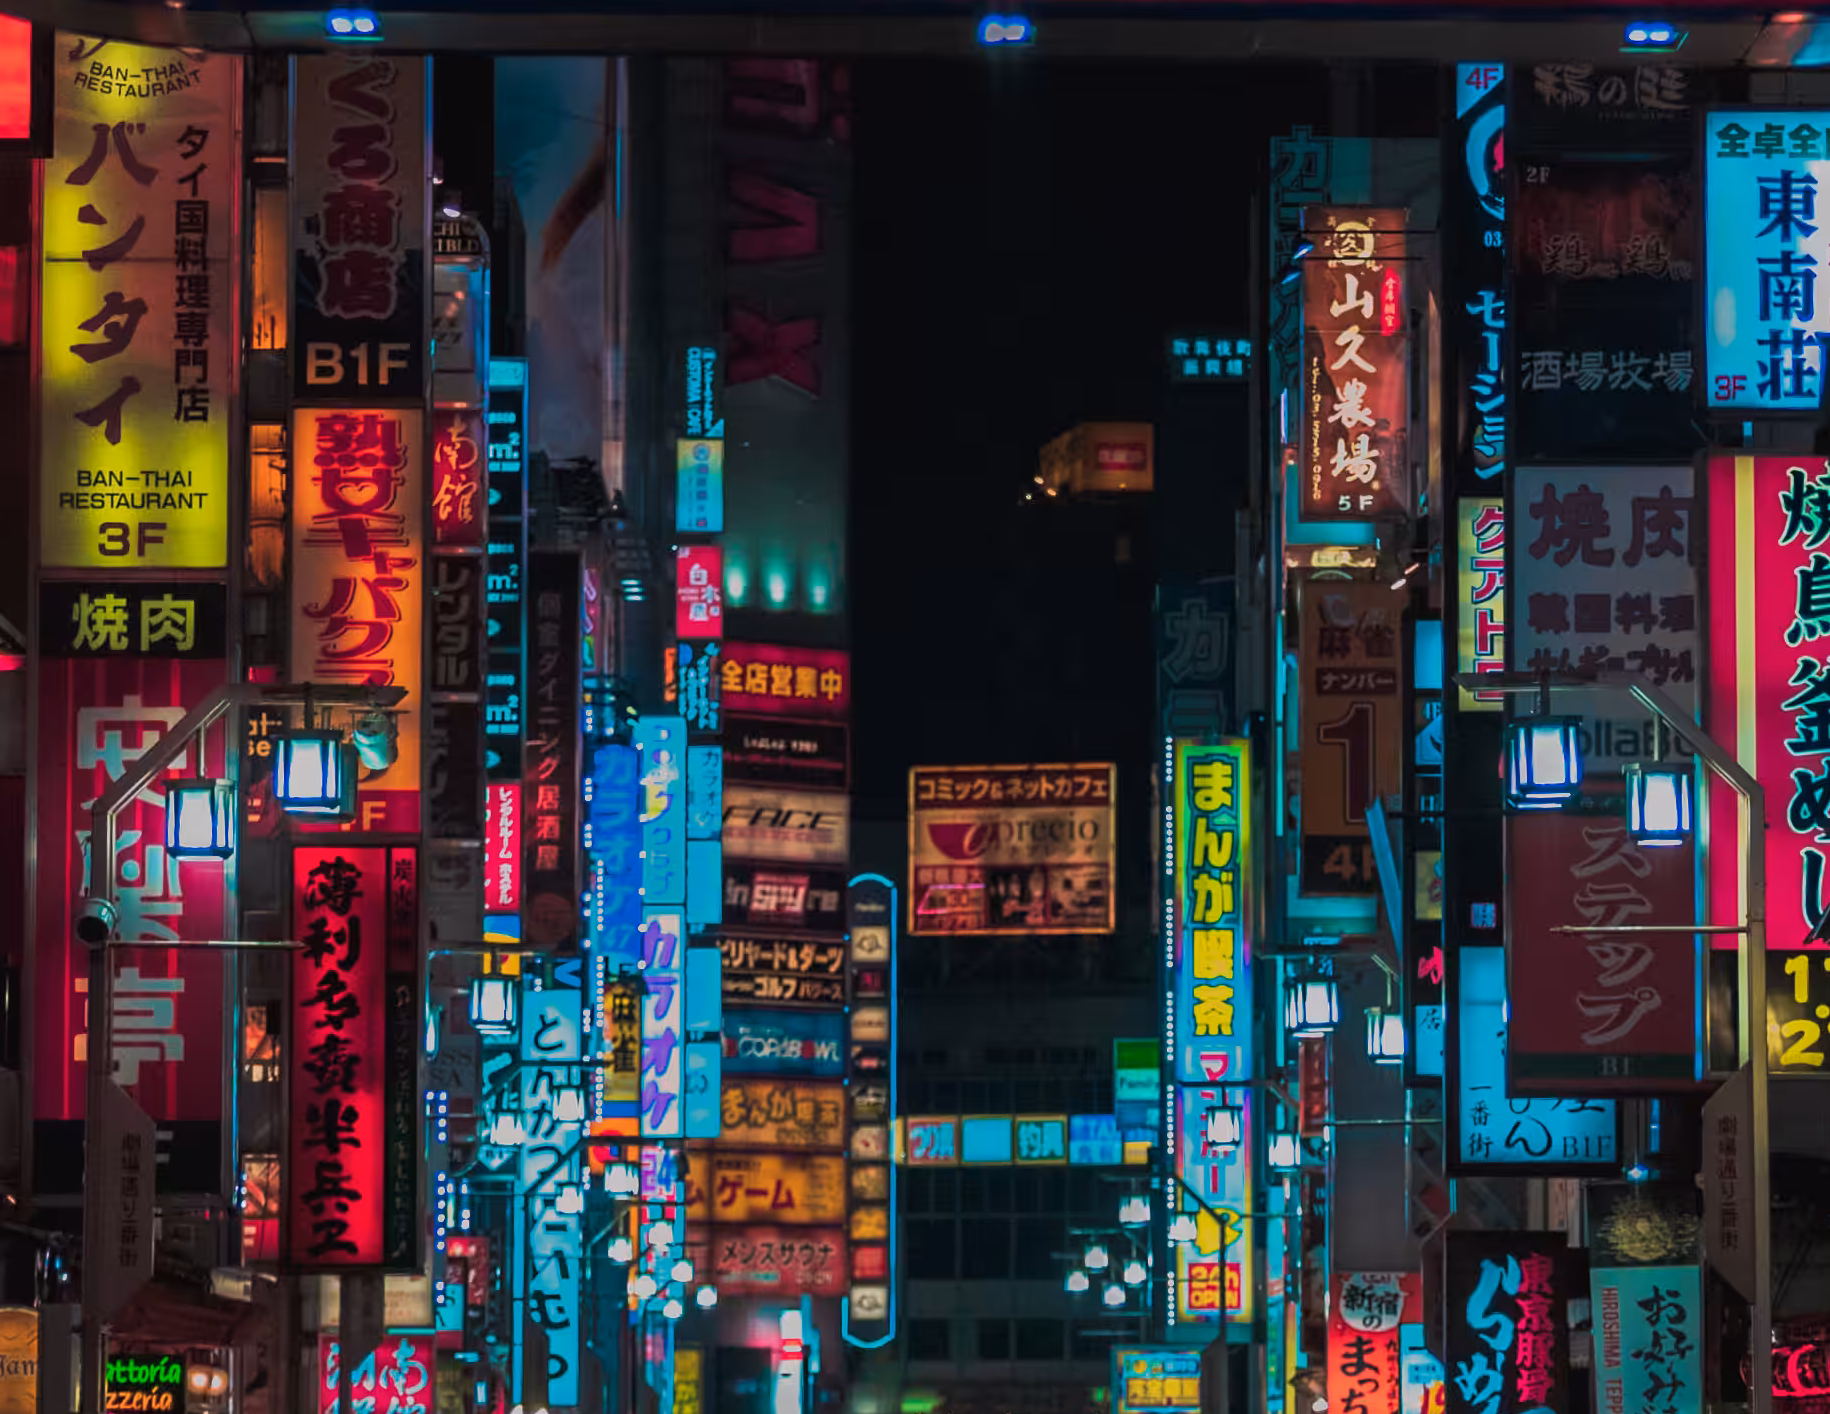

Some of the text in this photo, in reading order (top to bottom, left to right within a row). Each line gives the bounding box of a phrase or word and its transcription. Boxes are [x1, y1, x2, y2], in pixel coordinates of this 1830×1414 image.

[73, 68, 201, 99] RESTAURANT
[90, 60, 184, 82] BAN-THAI
[1466, 67, 1499, 90] 4F
[66, 121, 159, 445] バンタイ
[174, 124, 210, 423] タイ国料理専門店
[1755, 169, 1819, 401] 東南荘
[306, 342, 411, 387] B1F
[1327, 272, 1378, 484] 山久農場
[1521, 350, 1693, 392] 酒場牧場
[1714, 374, 1747, 401] 3F
[76, 470, 193, 488] BAN-THAI
[58, 492, 208, 511] RESTAURANT
[1337, 494, 1374, 512] 5F
[97, 521, 168, 557] 3F
[72, 593, 196, 652] 焼肉
[721, 659, 843, 703] 全店営業中
[1318, 701, 1375, 825] 1
[1570, 826, 1662, 1046] ステップ
[1563, 1135, 1613, 1159] B1F
[1601, 1288, 1619, 1369] HIROSHIMA
[108, 1356, 182, 1386] attoria
[107, 1387, 174, 1412] zzeria
